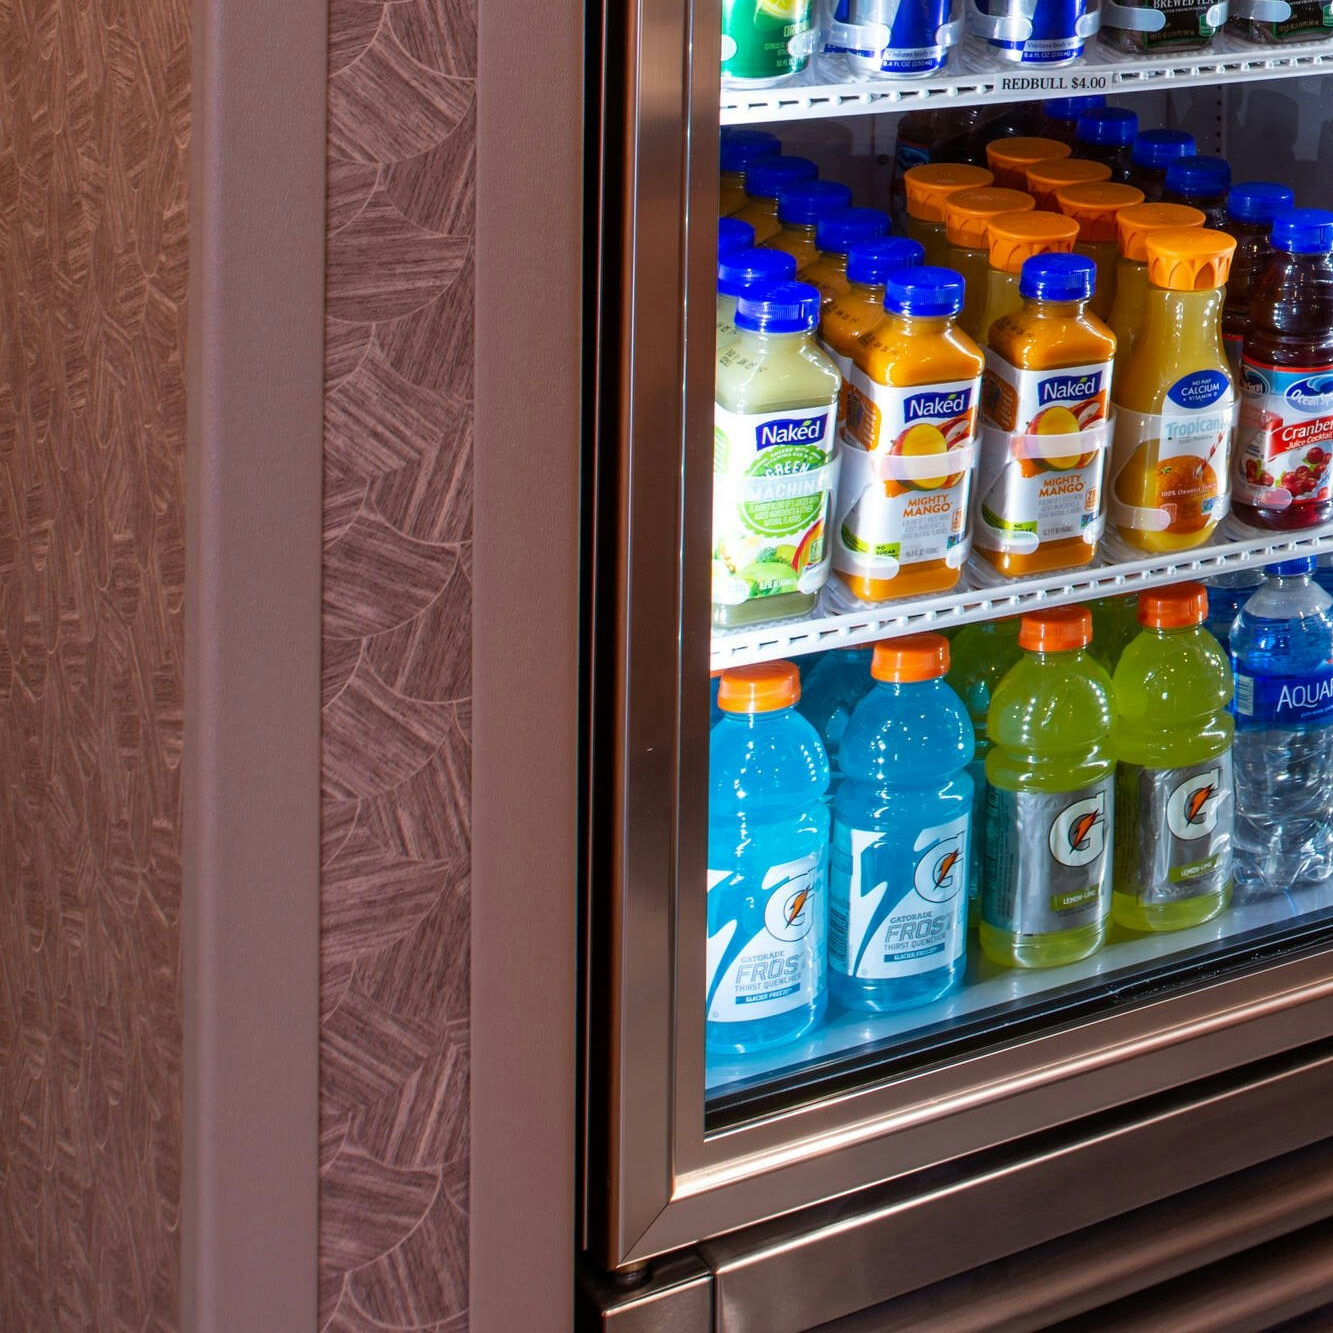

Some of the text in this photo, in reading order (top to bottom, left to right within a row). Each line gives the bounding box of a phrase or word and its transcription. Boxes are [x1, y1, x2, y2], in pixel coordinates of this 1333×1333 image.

[1002, 77, 1106, 90] REDBULL $4.00
[1044, 376, 1096, 400] Naked
[1181, 383, 1220, 395] CALCIUM
[909, 393, 965, 417] Naked
[761, 421, 820, 445] Naked
[1044, 475, 1082, 488] MIGHTY
[1039, 483, 1084, 497] MANGO
[908, 495, 948, 507] MIGHTY
[903, 503, 951, 518] MANGO
[890, 911, 932, 923] GATORADE
[884, 933, 946, 951] THIRST QUENCHER
[741, 951, 784, 962] GATORADE
